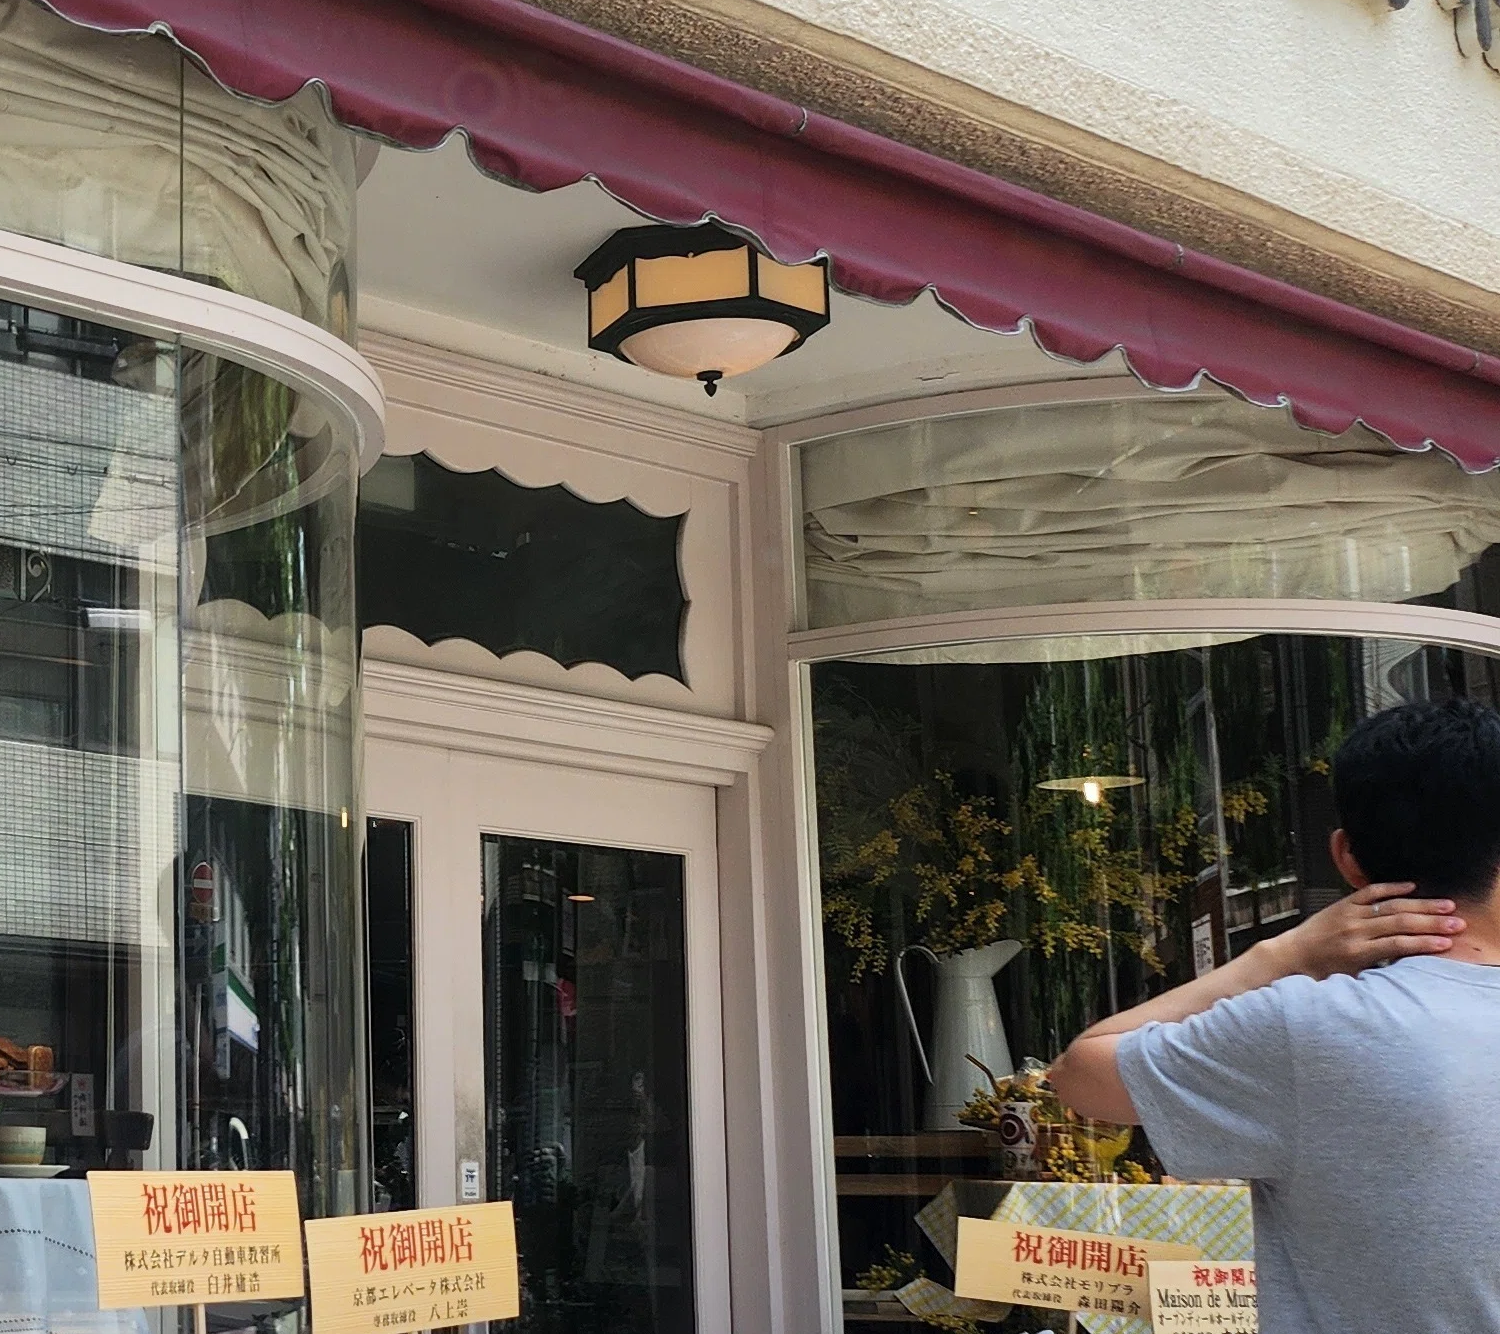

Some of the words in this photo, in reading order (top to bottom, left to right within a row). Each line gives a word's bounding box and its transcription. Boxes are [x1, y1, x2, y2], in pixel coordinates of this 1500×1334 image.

[141, 1183, 256, 1235] 祝御開店
[124, 1244, 281, 1271] 株式会社デルタ自動車教習所
[358, 1217, 473, 1274] 祝御開店
[1012, 1231, 1147, 1278] 祝御開店
[151, 1278, 195, 1296] 代表取締役
[353, 1272, 486, 1306] 京都エレベータ株式会社
[1157, 1288, 1202, 1308] Maison
[1208, 1288, 1220, 1308] de
